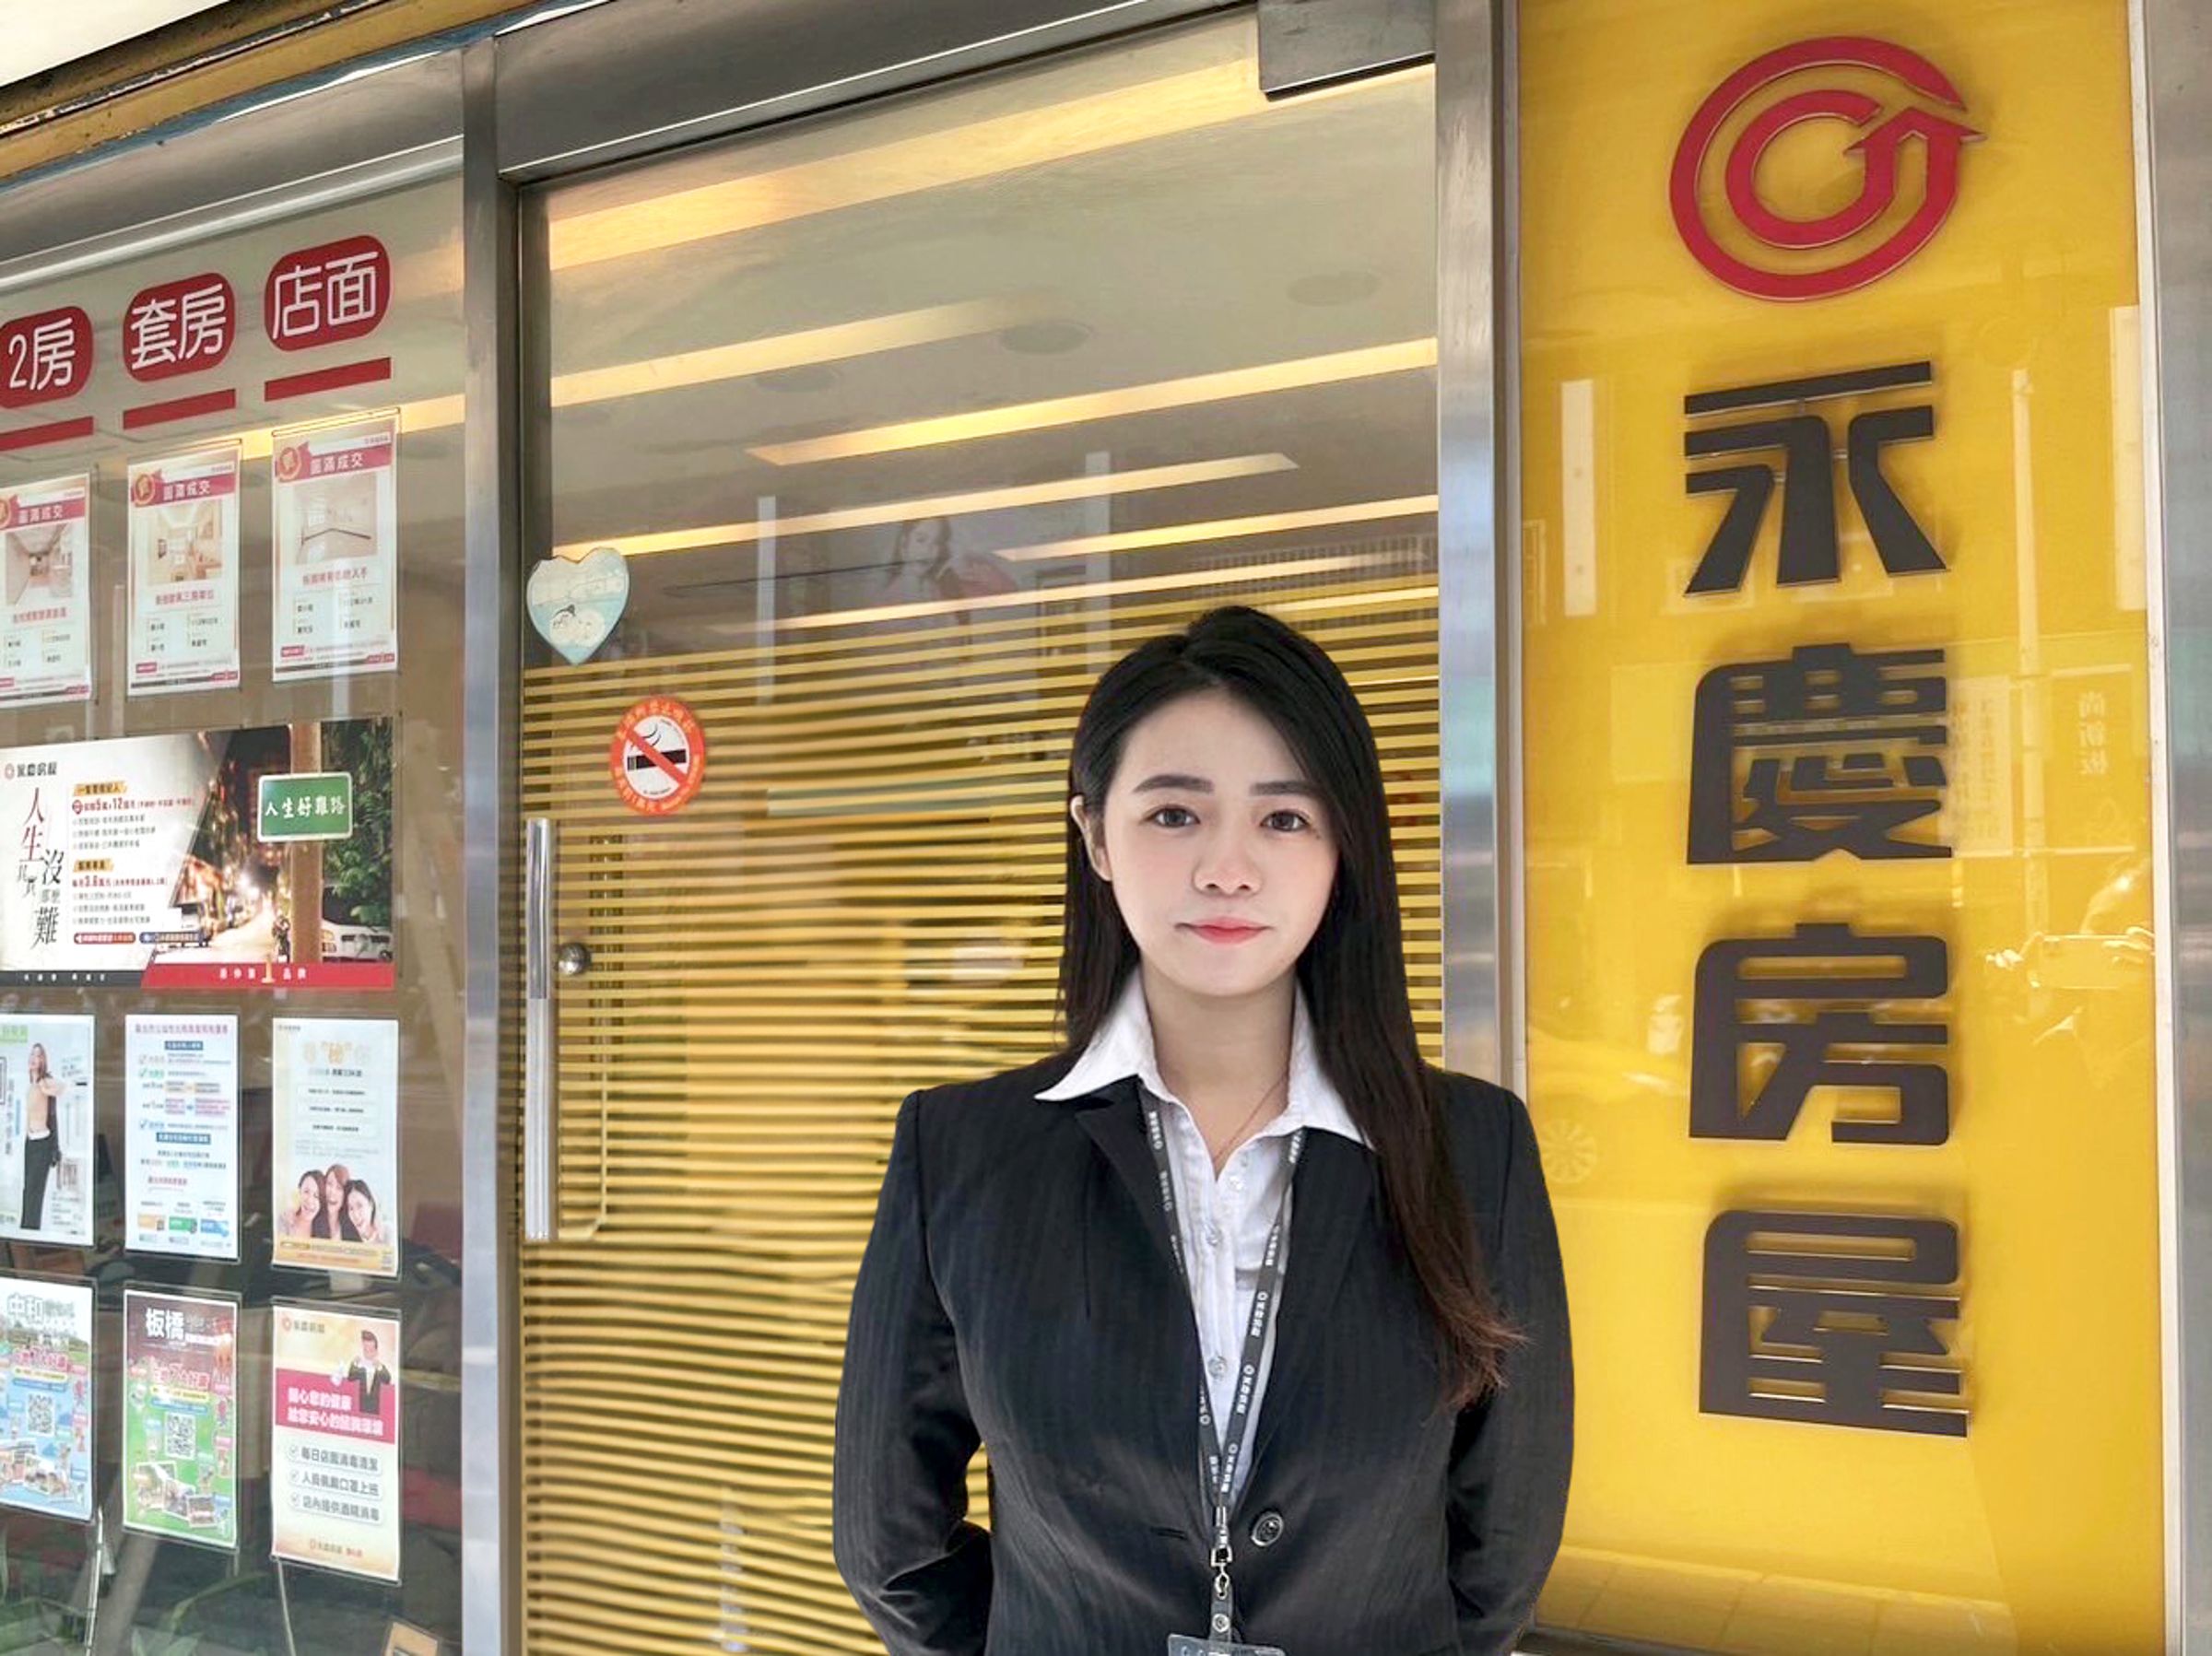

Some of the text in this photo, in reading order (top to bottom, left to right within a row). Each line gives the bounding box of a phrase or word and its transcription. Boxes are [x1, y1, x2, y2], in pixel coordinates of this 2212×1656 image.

[130, 283, 228, 370] 套房
[272, 251, 380, 340] 店面
[7, 317, 76, 391] 2房
[1683, 359, 1970, 1439] 永慶房屋
[146, 1307, 184, 1340] 板橋
